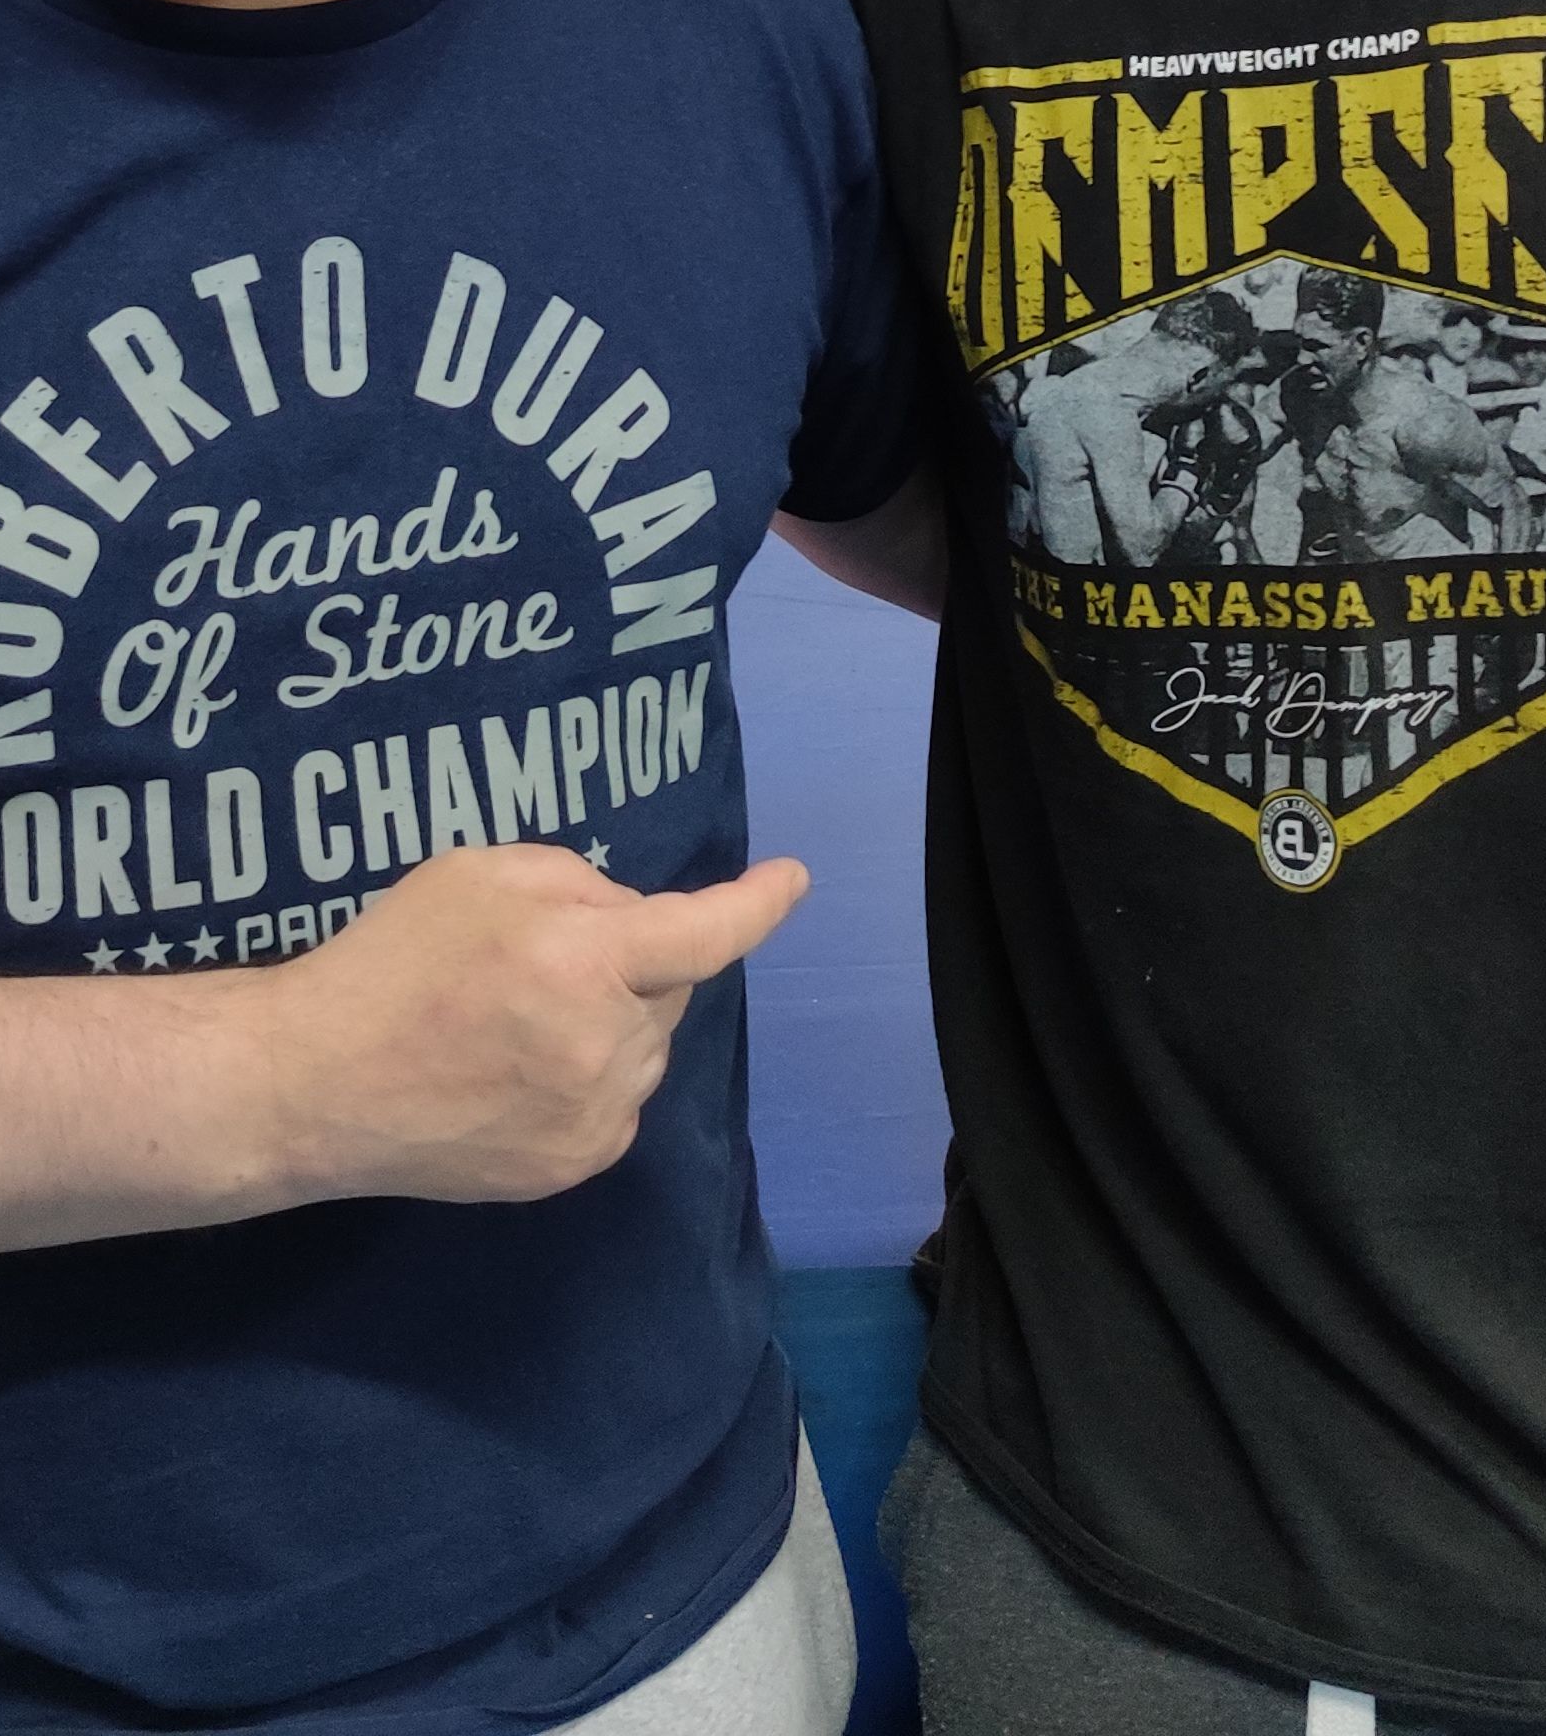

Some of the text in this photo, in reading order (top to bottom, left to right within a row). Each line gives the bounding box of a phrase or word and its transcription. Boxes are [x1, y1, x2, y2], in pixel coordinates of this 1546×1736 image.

[1129, 28, 1421, 78] HEAVYWEIGHT CHAMP
[414, 250, 718, 657] DURAN
[154, 466, 518, 607] Hands
[1084, 577, 1377, 631] MANASSA
[100, 590, 575, 750] Of Stone
[1151, 666, 1455, 738] Jack Dempsey
[293, 661, 713, 883] CHAMPION
